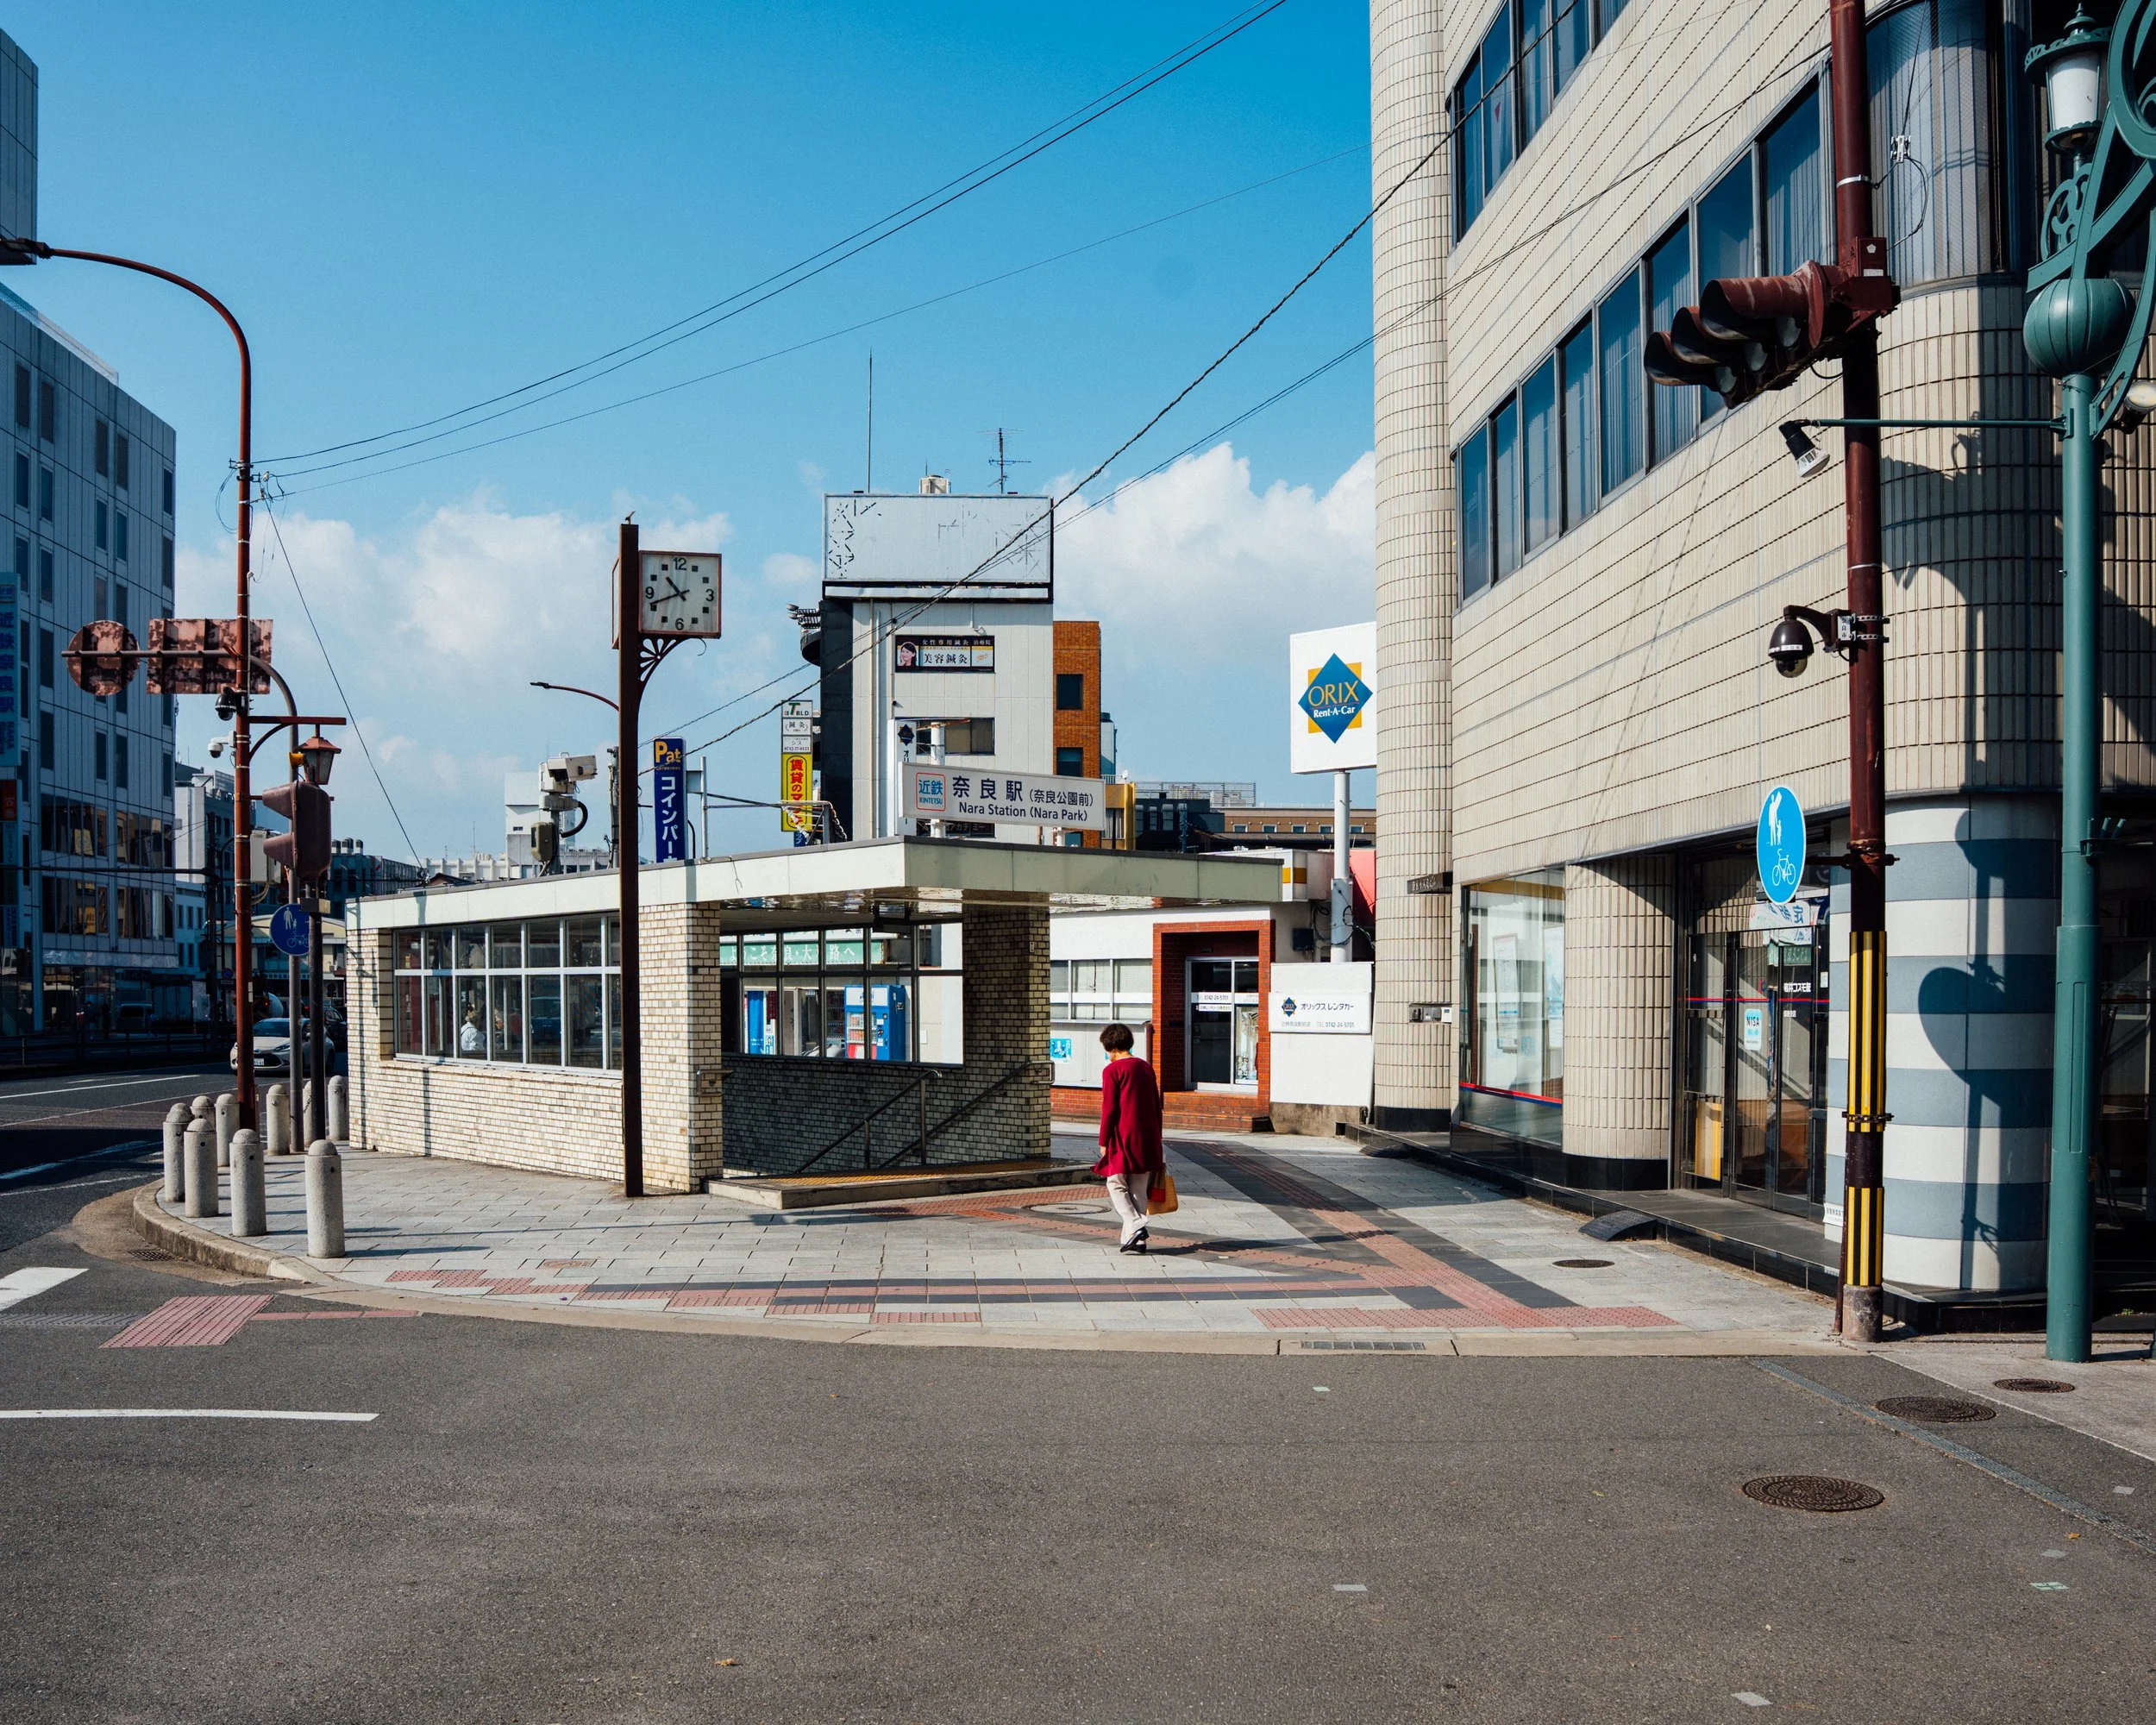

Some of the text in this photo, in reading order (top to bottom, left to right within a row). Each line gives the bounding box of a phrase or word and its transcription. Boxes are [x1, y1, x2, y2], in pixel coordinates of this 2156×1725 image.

[674, 557, 687, 570] 12
[645, 586, 655, 599] 9
[705, 589, 714, 601] 3
[675, 618, 684, 630] 6
[924, 654, 968, 664] 美容鍼灸
[1308, 681, 1359, 706] ORIX
[1313, 706, 1356, 718] Rent-A-Car
[655, 741, 681, 763] Pat
[918, 779, 943, 795] 近鉄
[952, 775, 1094, 807] 奈良駅 （奈良公園前）
[918, 797, 943, 806] KINTETSU
[959, 801, 1087, 822] Nara Station (Nara Park)
[730, 944, 855, 962] よこそ奈良・大路へ
[1746, 1016, 1760, 1026] NISA
